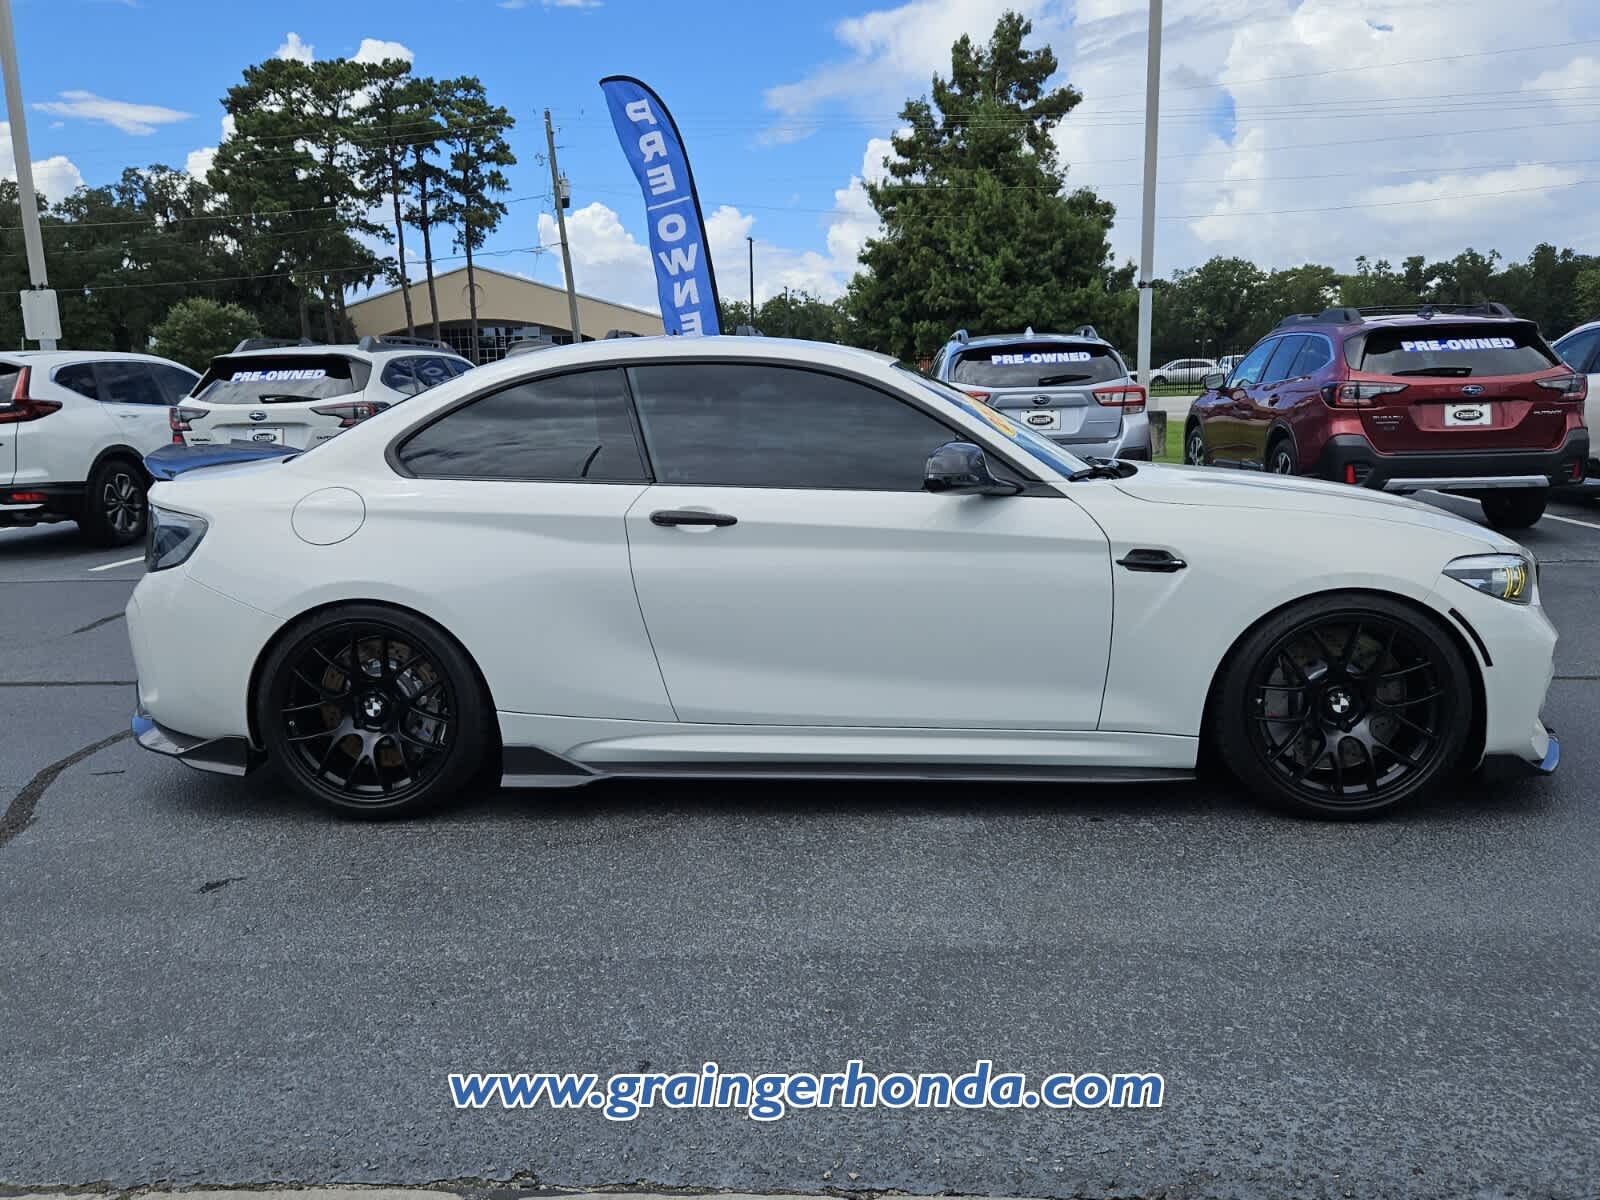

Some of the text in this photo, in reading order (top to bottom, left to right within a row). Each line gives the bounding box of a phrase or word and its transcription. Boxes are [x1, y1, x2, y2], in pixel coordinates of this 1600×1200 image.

[1400, 338, 1516, 352] PRE-OWNED
[991, 351, 1091, 365] PRE-OWNED
[230, 369, 326, 382] PRE-OWNED
